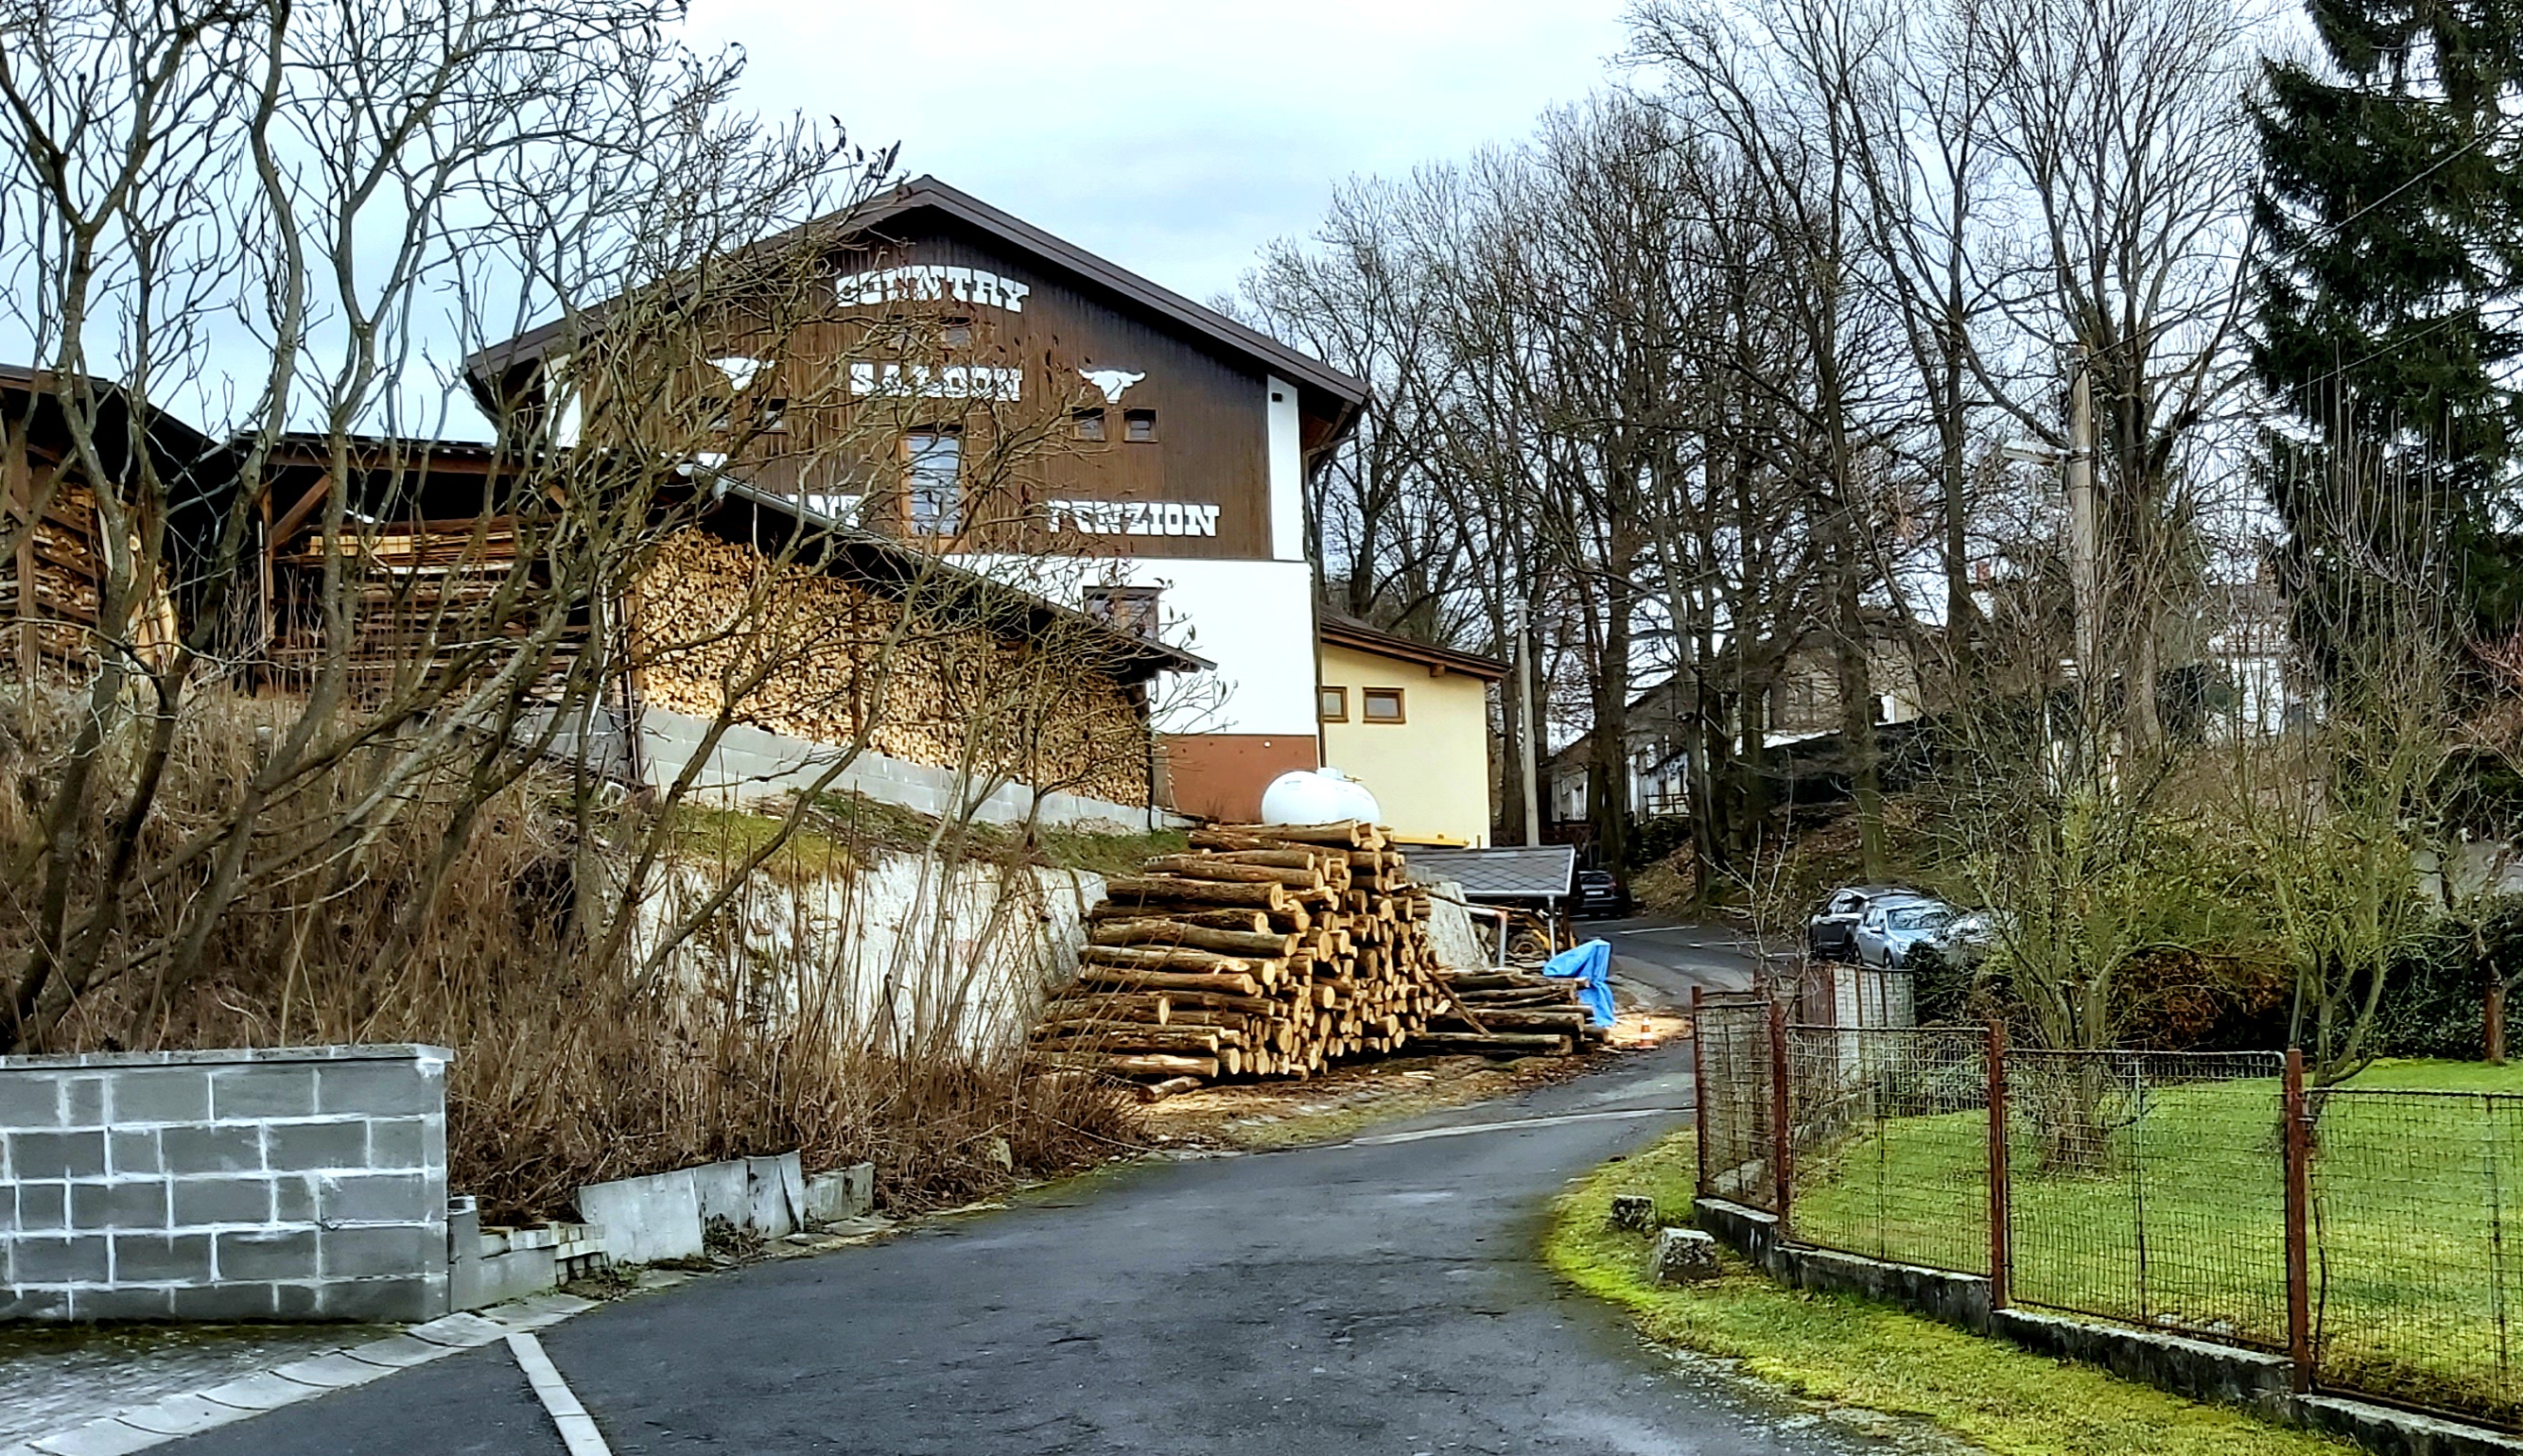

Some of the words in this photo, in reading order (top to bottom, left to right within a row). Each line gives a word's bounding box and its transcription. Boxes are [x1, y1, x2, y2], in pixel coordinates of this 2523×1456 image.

[836, 265, 1030, 313] COUNTRY
[850, 363, 1023, 401] SALOON
[1047, 499, 1220, 536] PENZION
